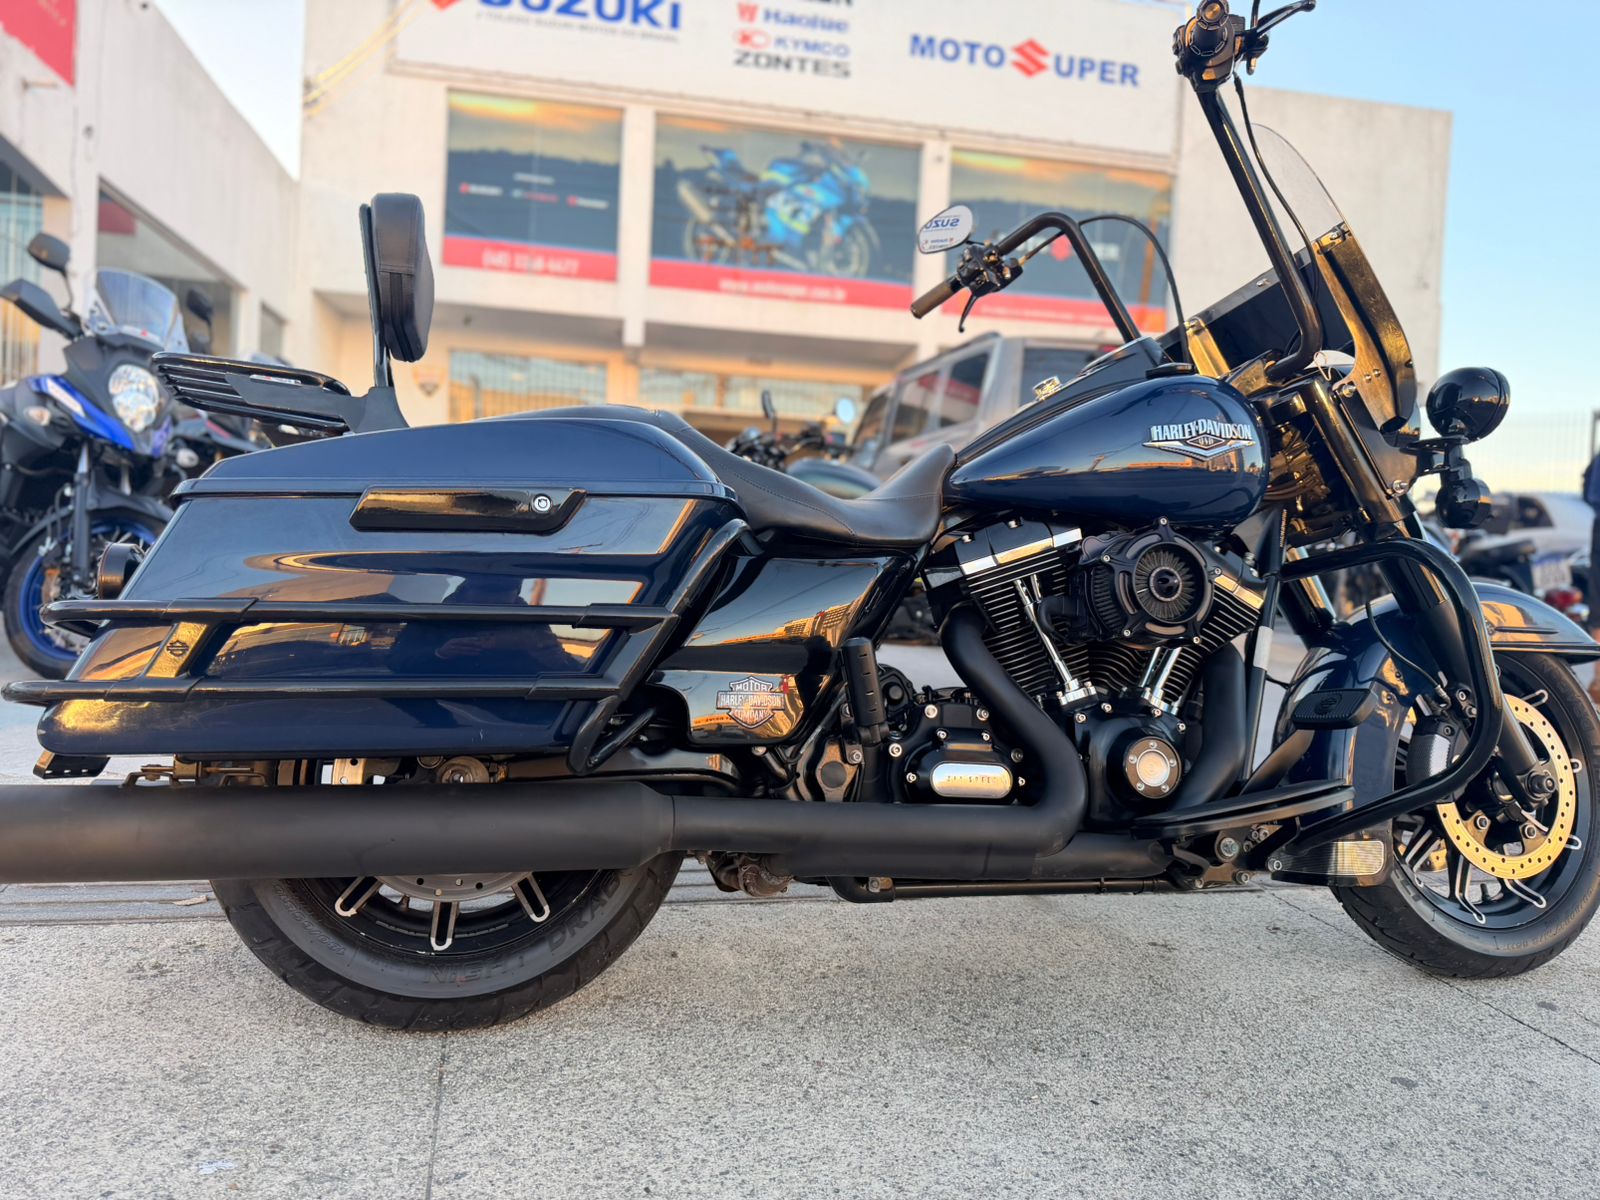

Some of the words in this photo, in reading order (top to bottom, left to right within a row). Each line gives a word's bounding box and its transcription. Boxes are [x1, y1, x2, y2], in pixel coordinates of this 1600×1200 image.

[480, 0, 681, 30] ZUKI
[774, 36, 850, 58] KYMCO
[910, 33, 1005, 68] MOTO
[734, 50, 850, 79] ZONTES
[735, 680, 768, 692] MOTOR
